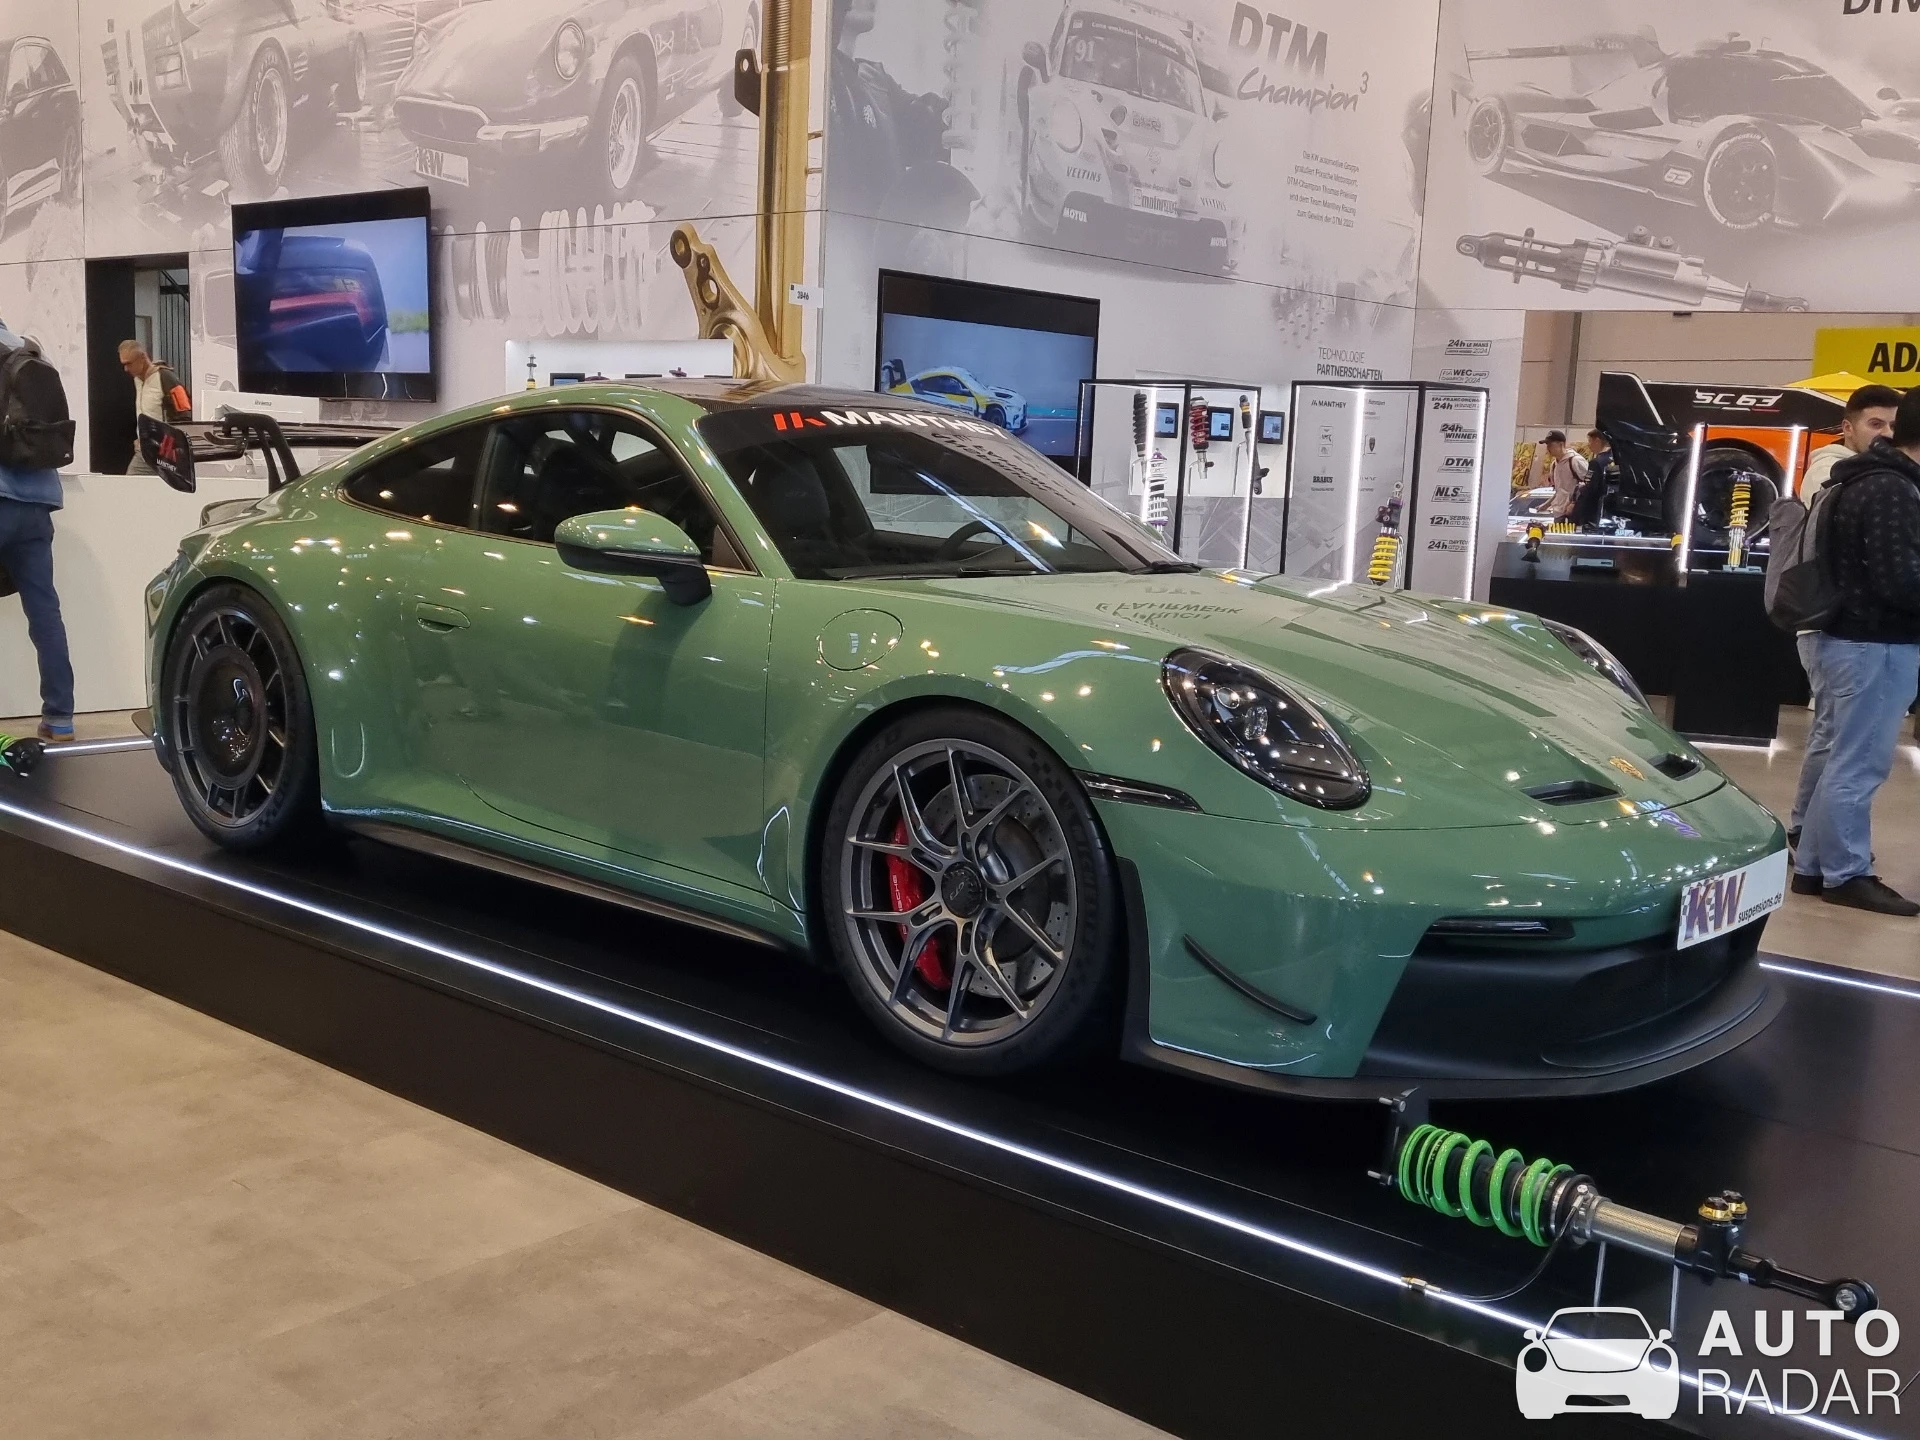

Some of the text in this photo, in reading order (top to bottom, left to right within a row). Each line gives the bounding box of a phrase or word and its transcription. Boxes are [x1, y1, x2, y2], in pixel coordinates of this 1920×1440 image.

[1228, 1, 1329, 79] DTM
[1074, 39, 1096, 62] 91
[1236, 66, 1369, 112] Champion 3
[1065, 166, 1102, 183] VELTINS
[1664, 167, 1693, 186] 63
[1062, 207, 1088, 223] MOTUL
[1447, 339, 1466, 348] 24h
[1318, 346, 1366, 364] TECHNOLOGIE
[1867, 342, 1920, 373] AD
[1316, 363, 1384, 381] PARTNERSCHAFTEN
[1453, 369, 1473, 377] WEC
[1318, 399, 1347, 409] MANTHEY
[1692, 388, 1784, 407] SC 63
[1433, 402, 1453, 410] 24h
[820, 410, 1009, 440] MANTHEY
[1441, 423, 1463, 432] 24h
[1445, 432, 1478, 440] WINNER
[1444, 457, 1475, 467] DTM
[1435, 486, 1461, 498] NLS
[1429, 516, 1450, 526] 12h
[1427, 540, 1448, 550] 24h
[1683, 870, 1783, 942] KW suspensions.de
